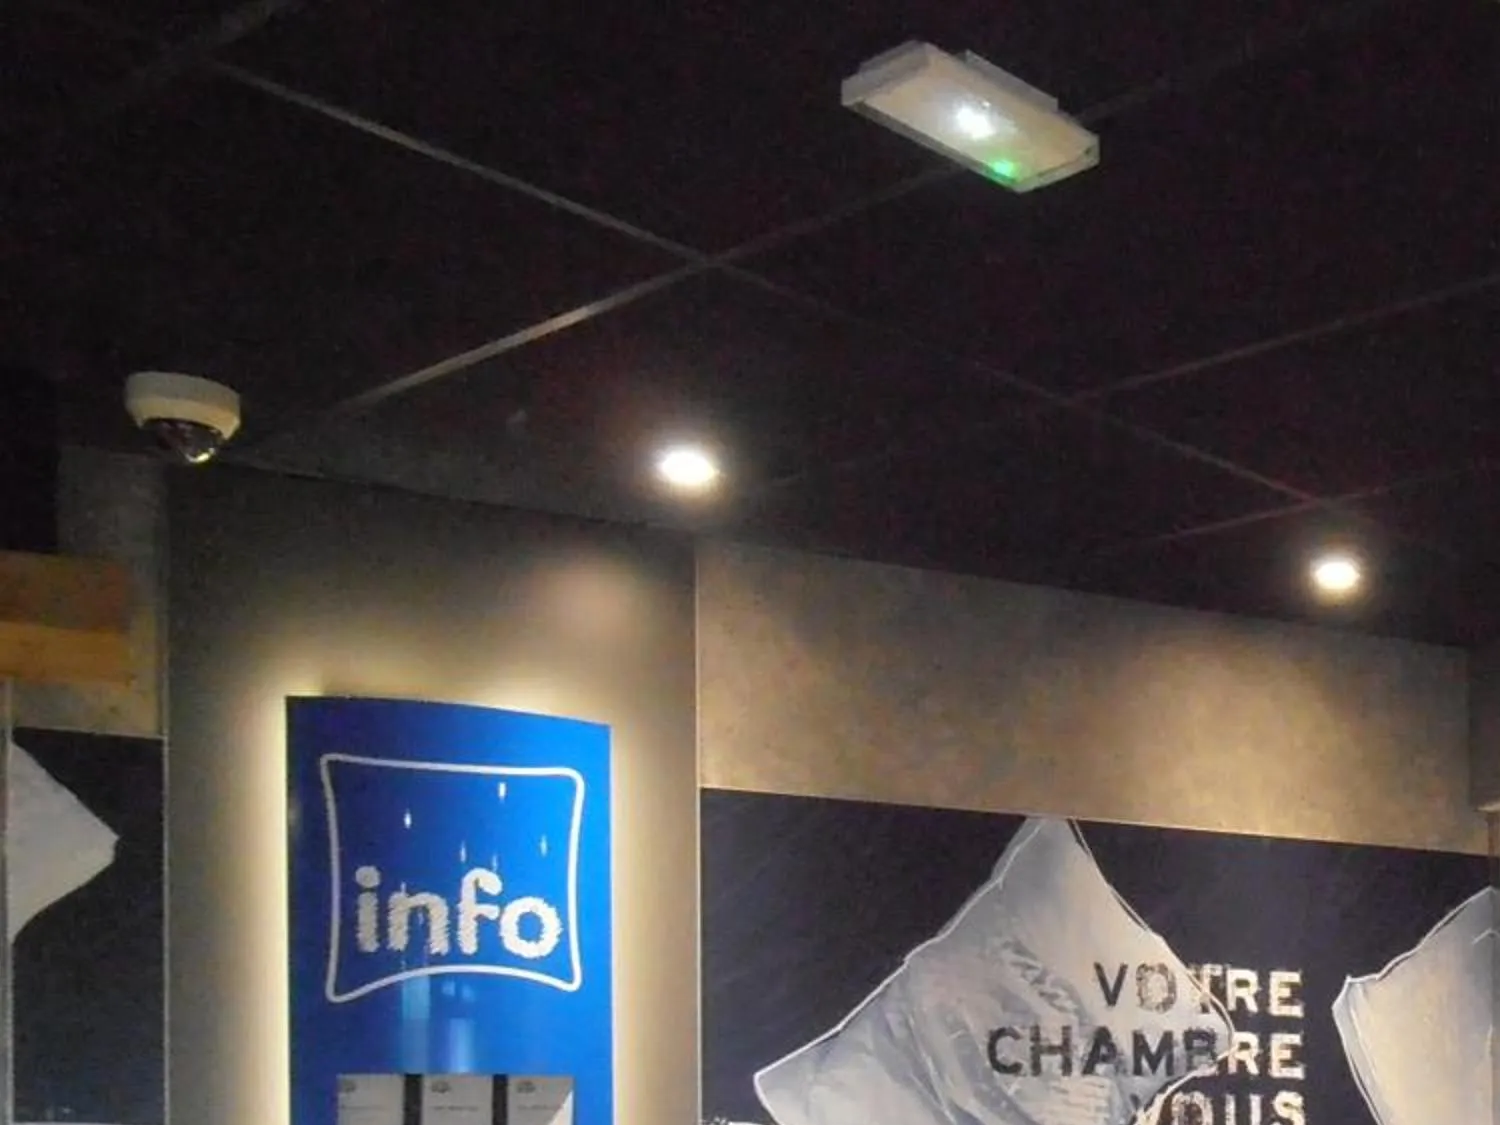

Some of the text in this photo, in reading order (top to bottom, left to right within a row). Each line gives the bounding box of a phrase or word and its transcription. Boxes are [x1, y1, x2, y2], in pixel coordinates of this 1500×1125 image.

[354, 865, 563, 959] info
[1093, 961, 1305, 1018] VOTRE
[987, 1024, 1305, 1080] CHAMBRE
